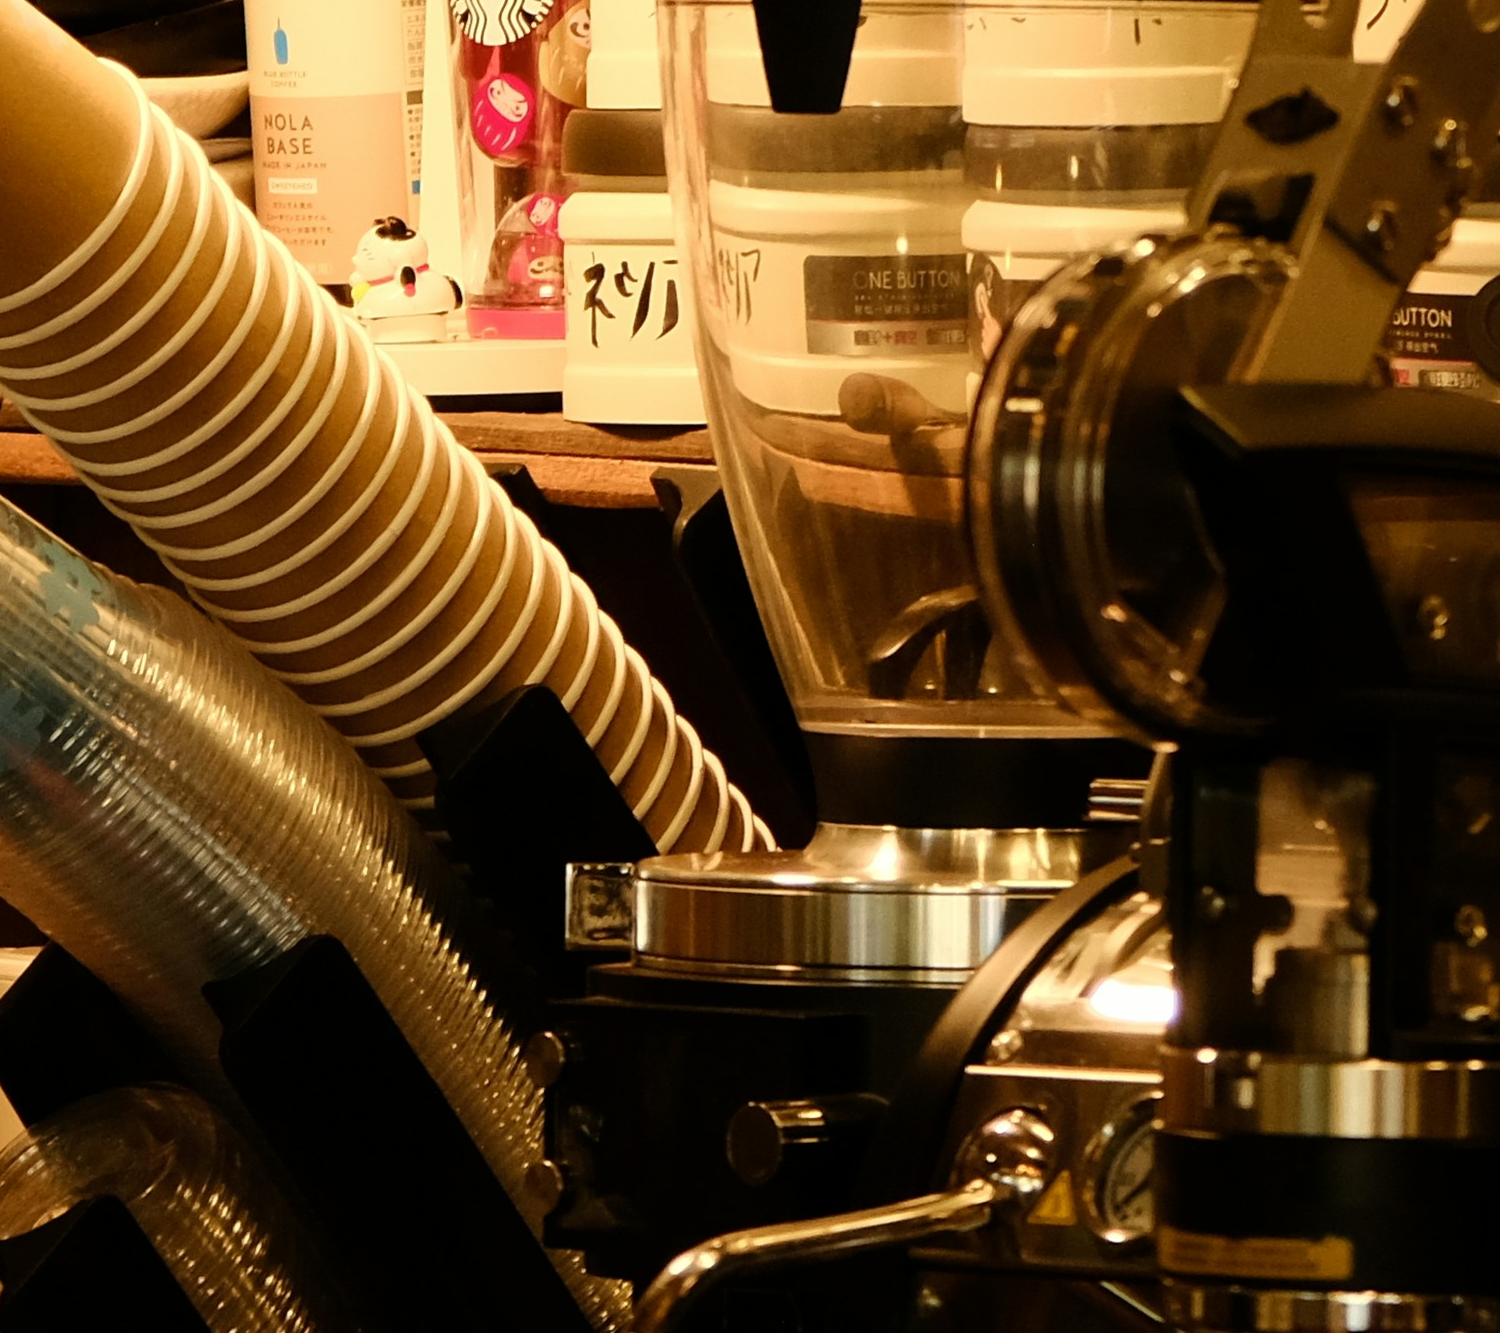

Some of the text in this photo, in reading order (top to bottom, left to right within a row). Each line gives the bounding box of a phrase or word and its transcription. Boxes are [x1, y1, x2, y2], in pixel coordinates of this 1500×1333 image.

[264, 113, 314, 132] NOLA
[266, 136, 314, 155] BASE
[853, 268, 961, 290] ONE BUTTON
